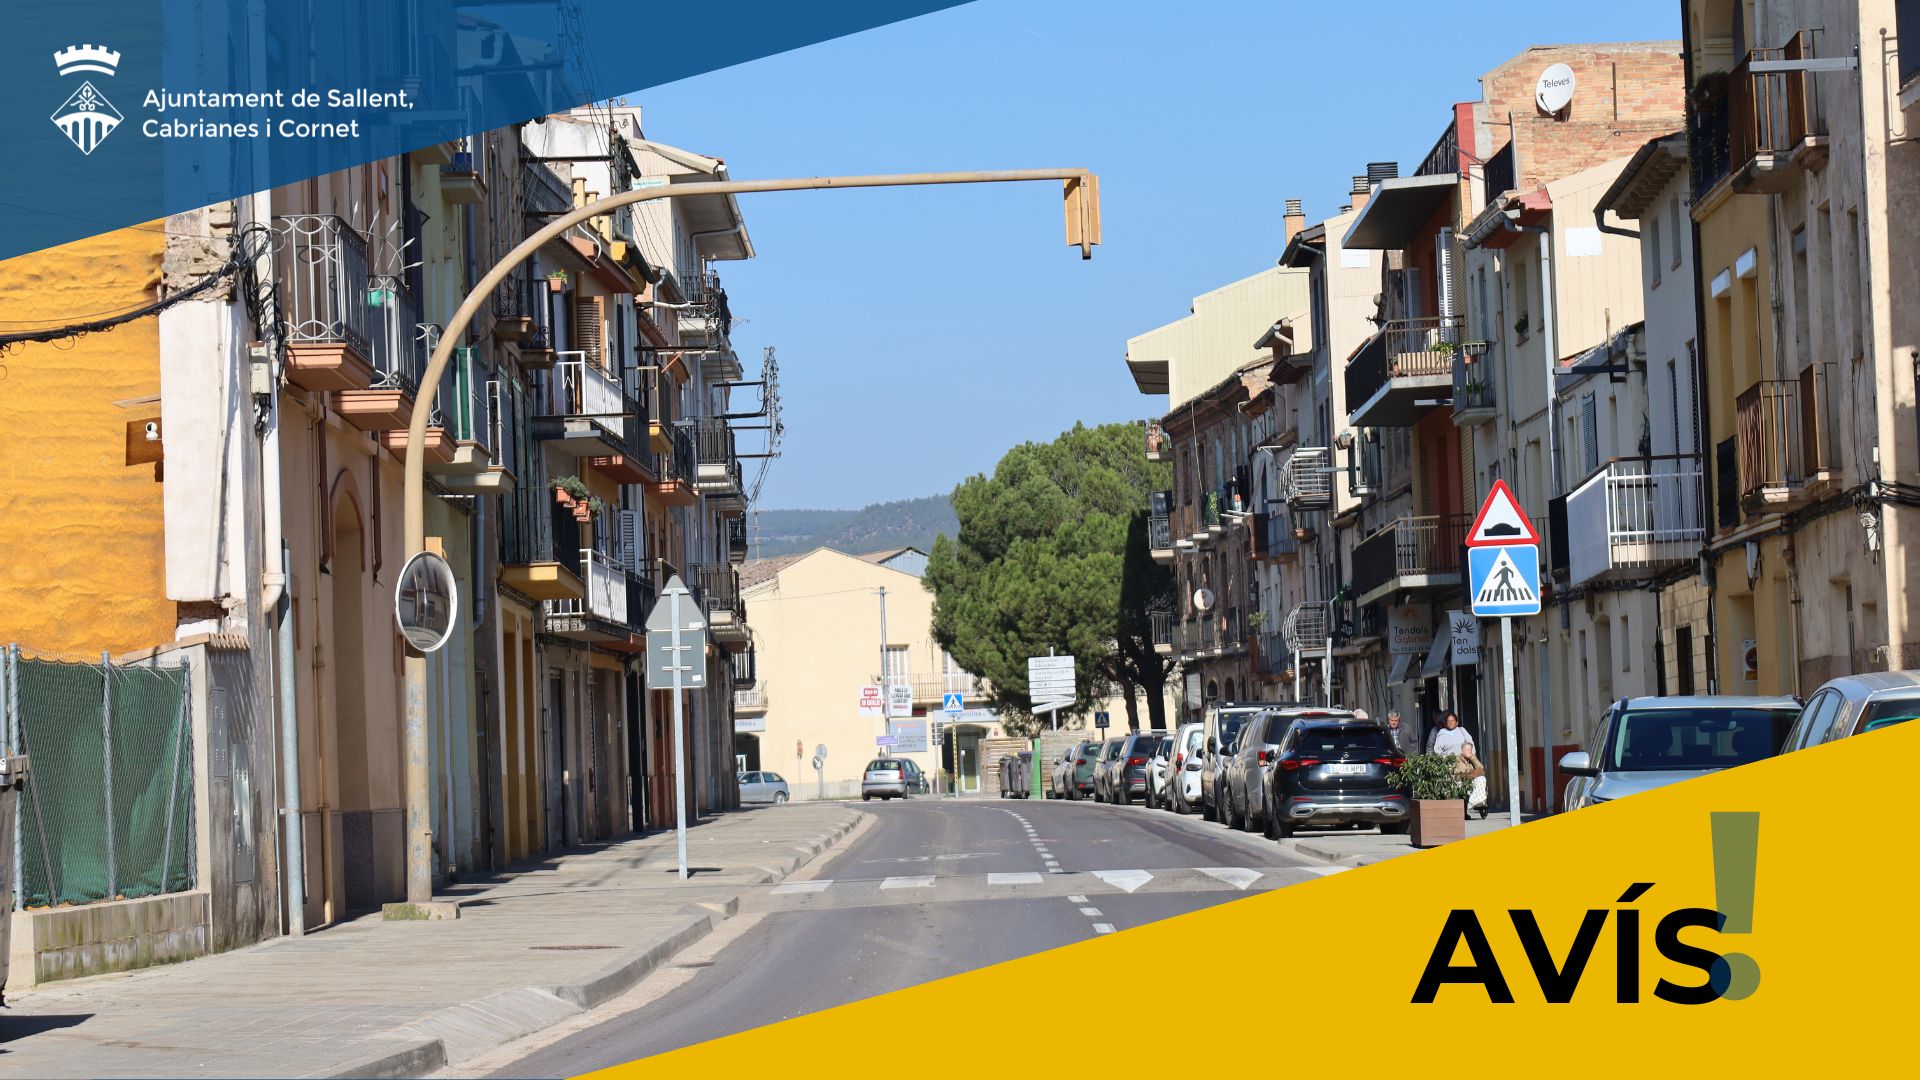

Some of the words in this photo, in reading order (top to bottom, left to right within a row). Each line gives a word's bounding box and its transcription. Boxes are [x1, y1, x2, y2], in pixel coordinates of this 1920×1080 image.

[1542, 78, 1570, 88] Televes
[1393, 625, 1428, 635] Tendals
[1394, 635, 1429, 645] Gabriel
[1452, 637, 1468, 646] Ten
